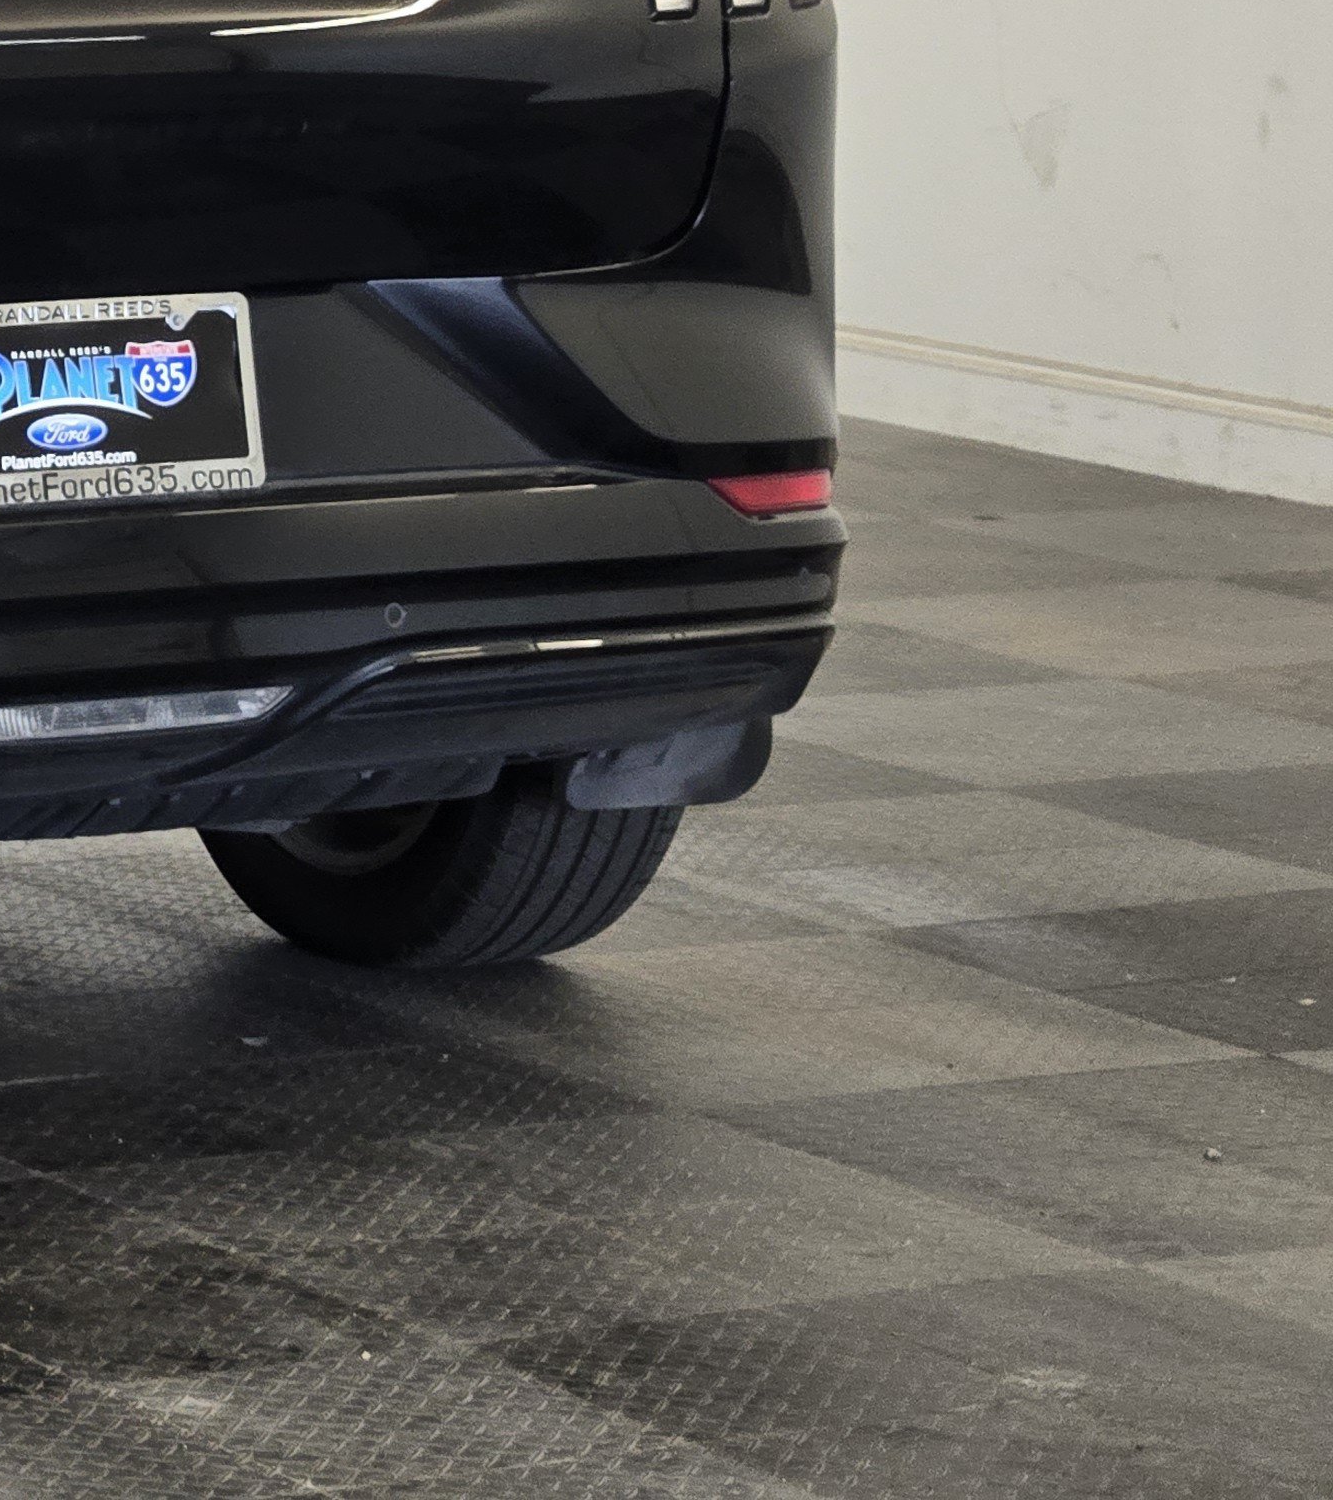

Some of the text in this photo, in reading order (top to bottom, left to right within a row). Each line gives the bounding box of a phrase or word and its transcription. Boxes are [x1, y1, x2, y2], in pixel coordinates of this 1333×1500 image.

[94, 299, 172, 320] REED'S
[139, 361, 187, 394] 635
[42, 420, 91, 445] Ford
[0, 451, 138, 472] PlanetFord635.com
